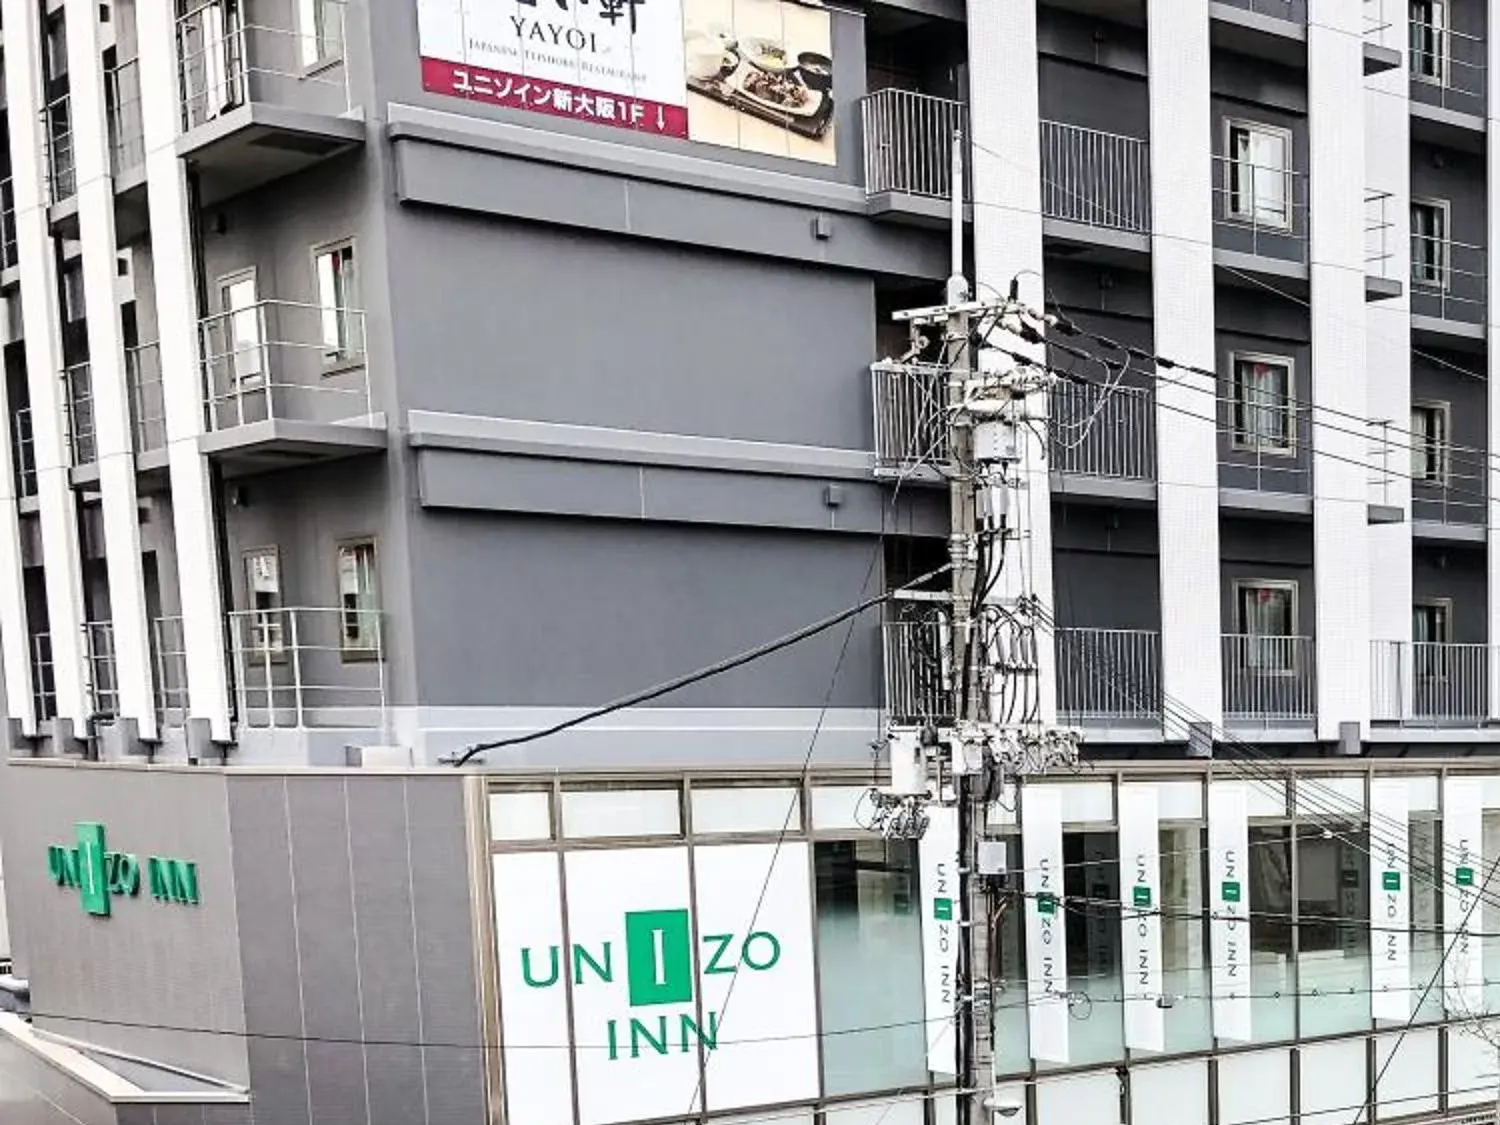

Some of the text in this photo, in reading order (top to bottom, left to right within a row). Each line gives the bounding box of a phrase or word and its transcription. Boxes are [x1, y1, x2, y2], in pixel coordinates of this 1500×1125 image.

[510, 15, 597, 53] YAYOI
[148, 857, 199, 904] INN
[934, 863, 952, 1003] UNIZO INN
[1037, 858, 1055, 993] UNIZO INN
[520, 908, 782, 1006] UNIZO
[1139, 949, 1149, 985] INN
[1227, 941, 1237, 977] INN
[607, 1011, 718, 1060] INN
